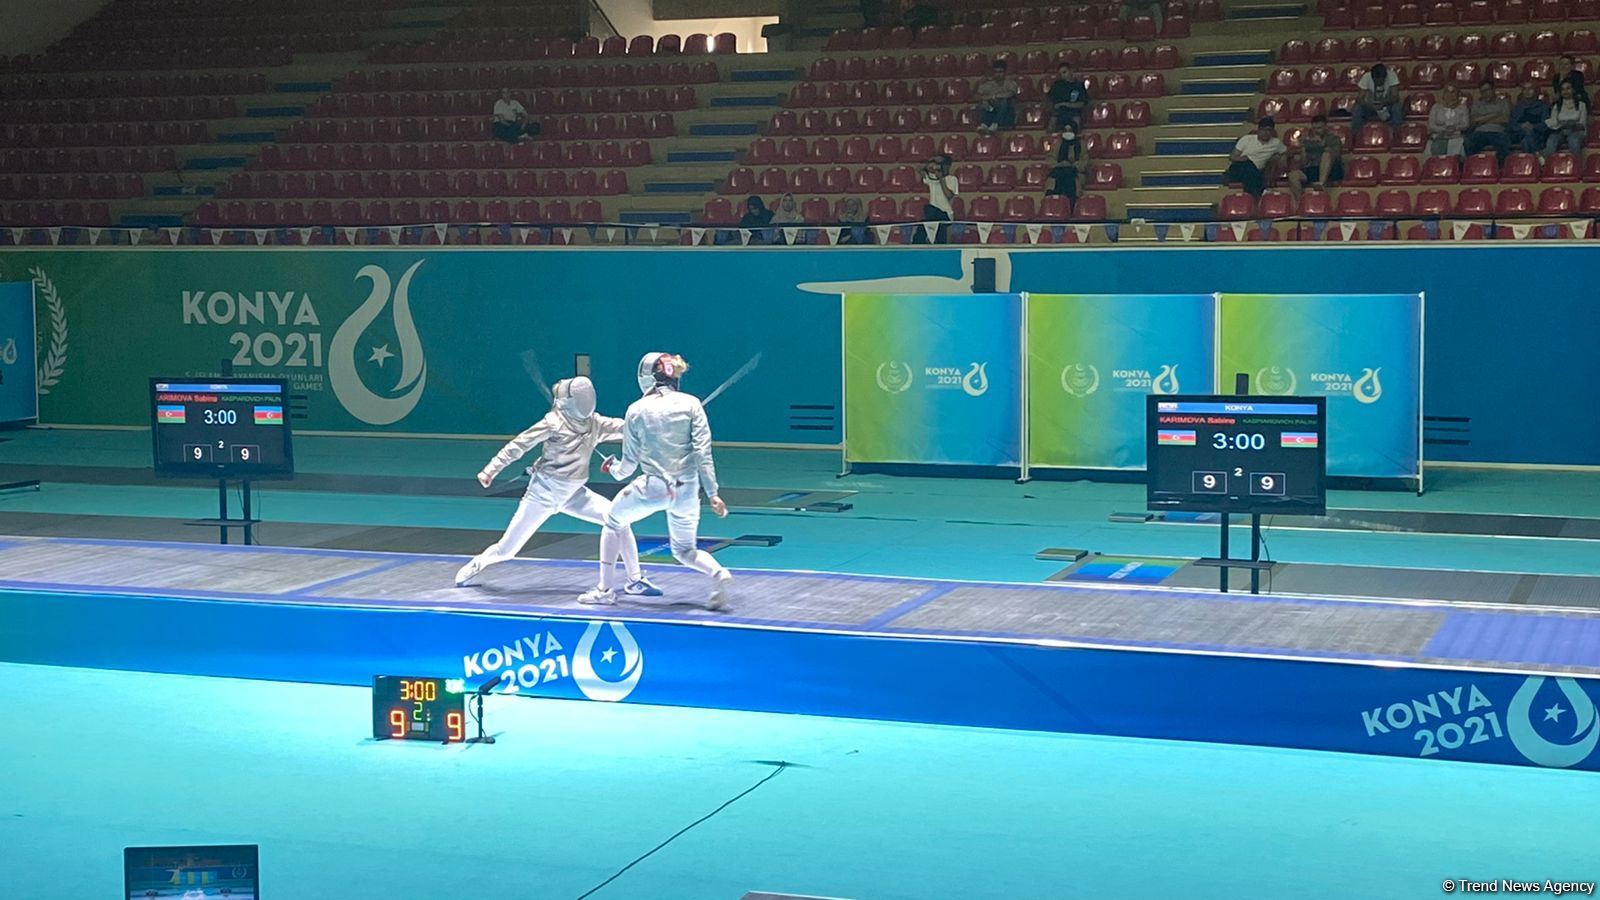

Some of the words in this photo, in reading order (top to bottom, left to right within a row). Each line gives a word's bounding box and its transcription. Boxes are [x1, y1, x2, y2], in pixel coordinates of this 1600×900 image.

[182, 291, 320, 326] KONYA
[229, 332, 322, 367] 2021
[925, 367, 961, 376] KONYA
[1112, 369, 1151, 379] KONYA
[1310, 372, 1352, 383] KONYA
[293, 382, 323, 392] GAMES
[938, 376, 962, 385] 2021
[1125, 378, 1152, 388] 2021
[1324, 382, 1352, 392] 2021
[1224, 404, 1254, 412] KONYA
[204, 409, 237, 425] 3:00
[1159, 416, 1206, 425] KARIMOVA
[218, 440, 225, 449] 2
[1212, 432, 1266, 451] 3:00
[193, 447, 203, 460] 9
[240, 448, 250, 461] 9
[1234, 467, 1243, 477] 2
[1203, 474, 1216, 489] 9
[1260, 476, 1274, 490] 9
[463, 631, 563, 678] KONYA
[501, 654, 569, 694] 2021
[400, 680, 436, 701] 3:00
[413, 701, 423, 721] 2
[1361, 683, 1493, 737] KONYA
[390, 710, 405, 738] 9
[447, 712, 462, 740] 9
[1413, 711, 1504, 757] 2021
